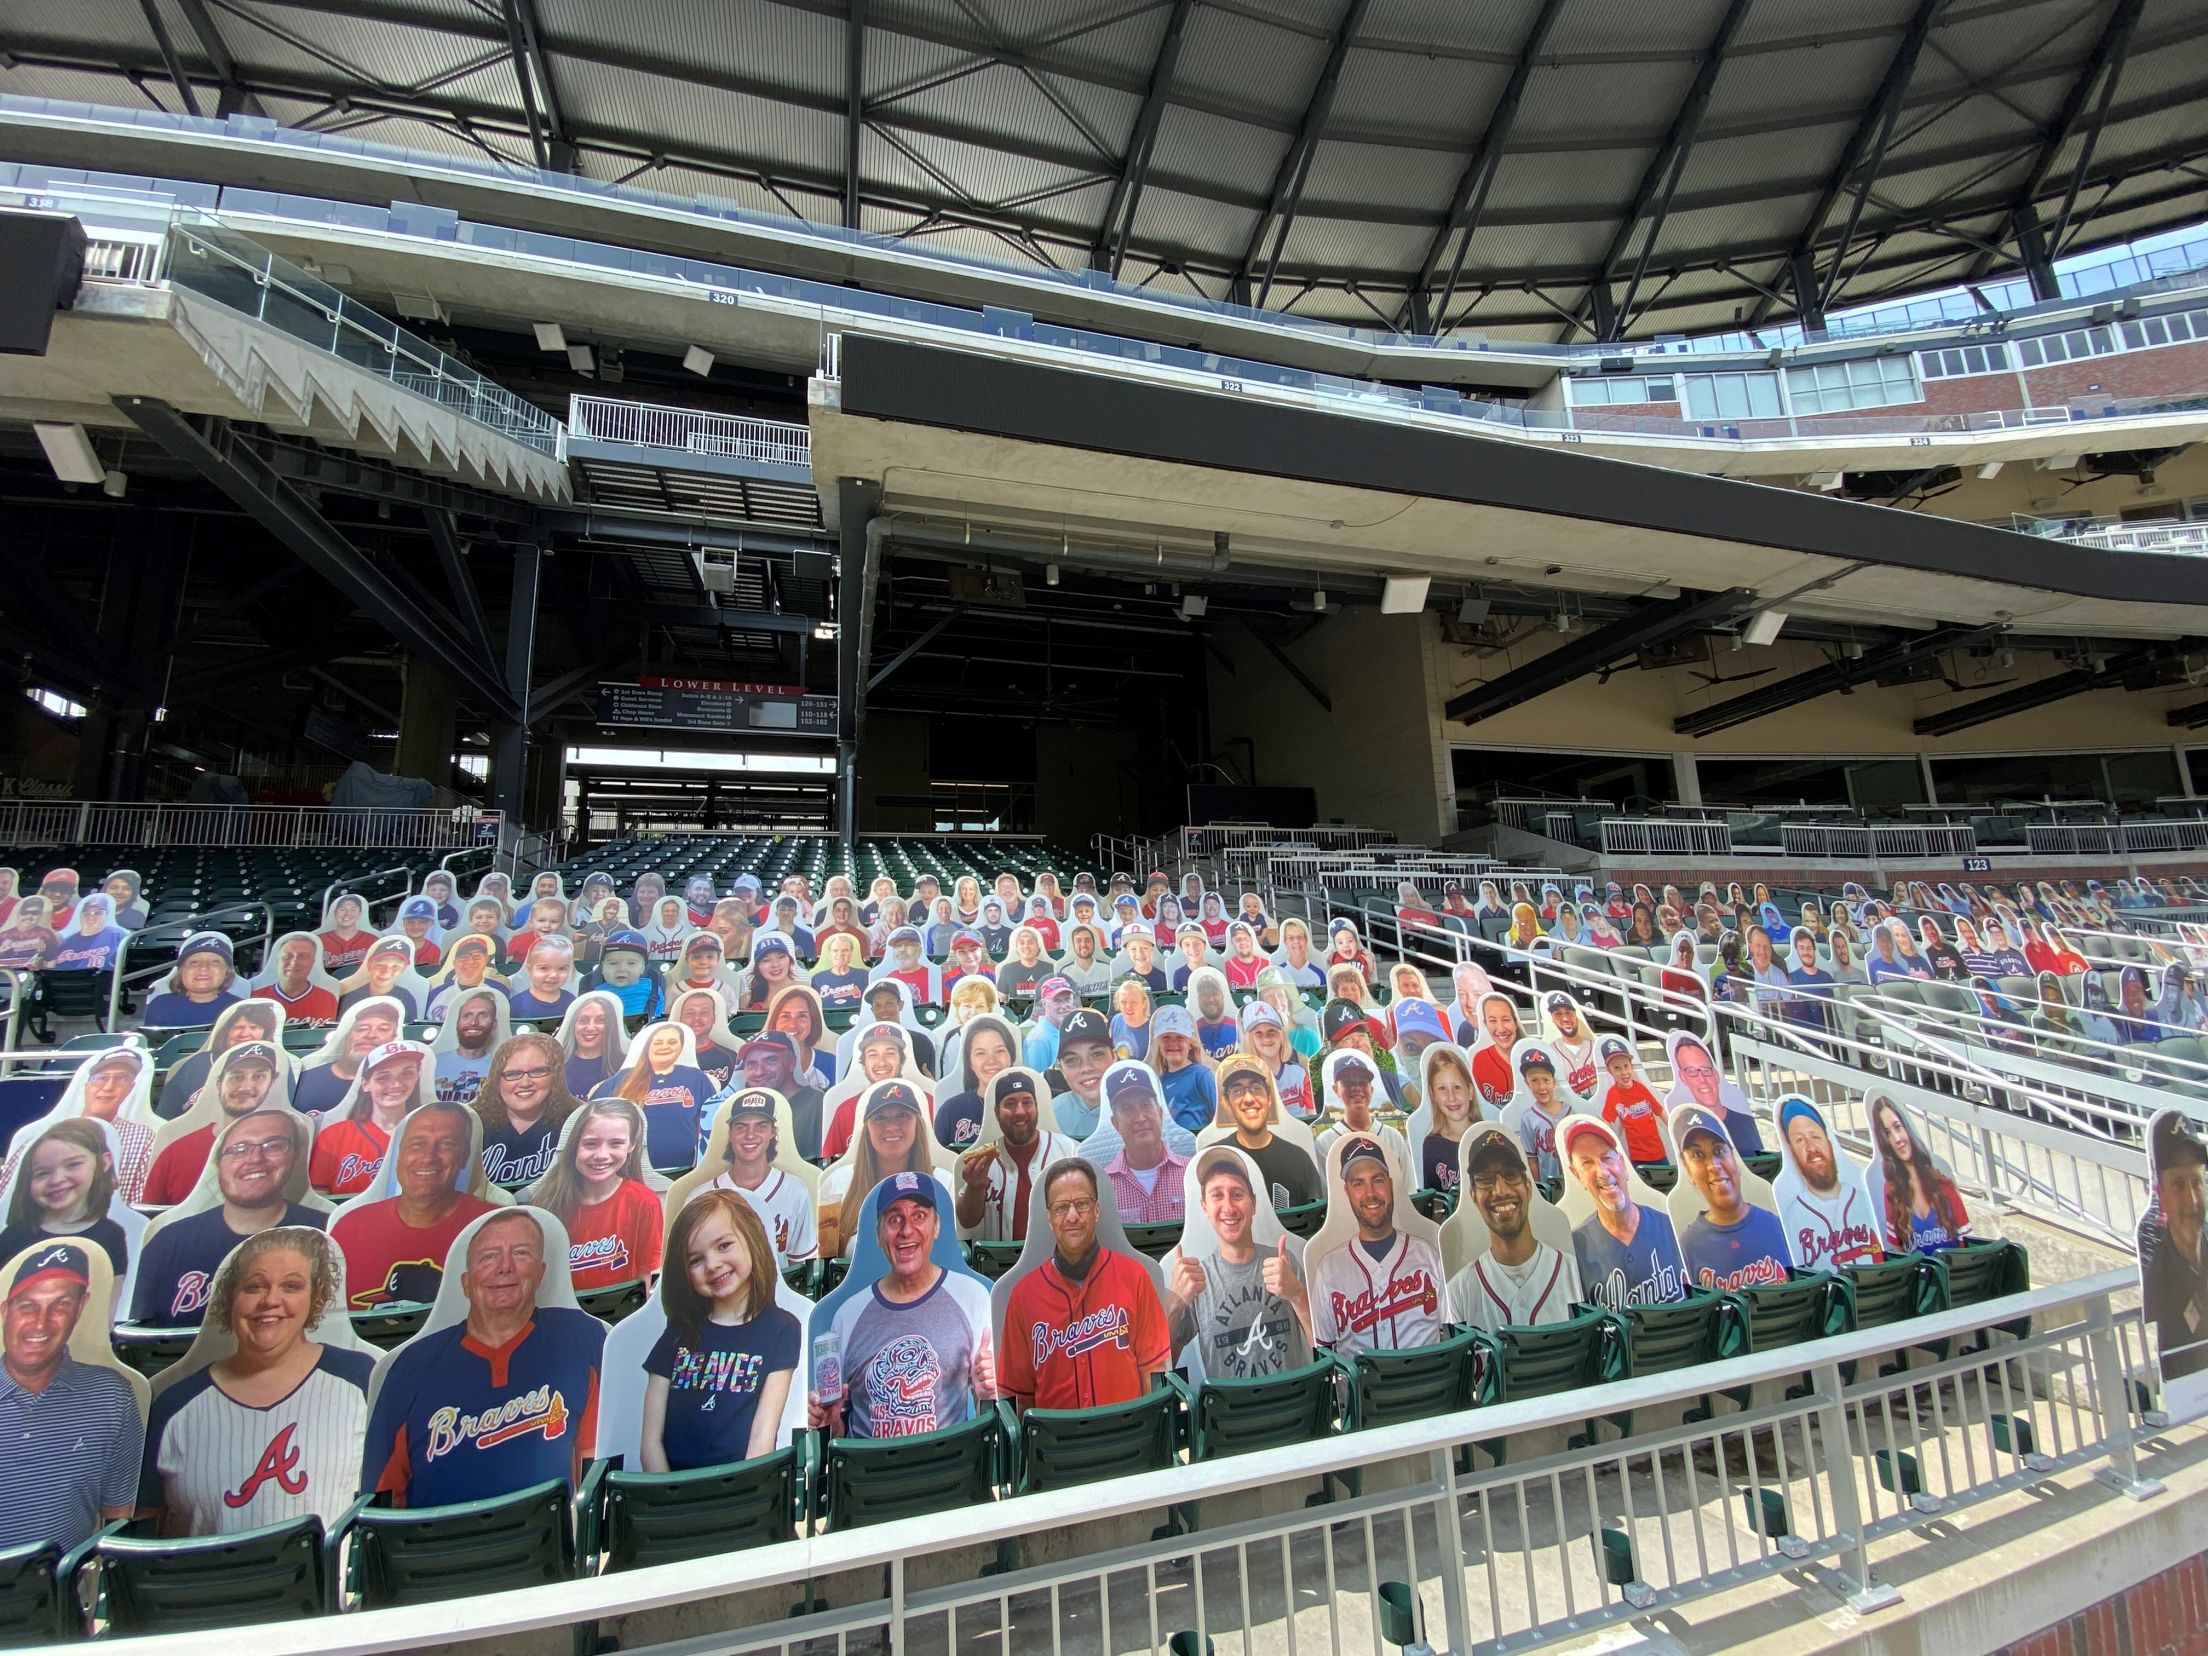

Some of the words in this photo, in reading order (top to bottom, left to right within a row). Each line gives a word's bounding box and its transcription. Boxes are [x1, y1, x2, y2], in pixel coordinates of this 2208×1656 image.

[713, 294, 734, 305] 320
[1224, 382, 1240, 392] 322
[661, 679, 720, 691] LOWER
[733, 683, 785, 695] LEVEL
[1968, 860, 1988, 871] 123
[760, 938, 778, 950] ATL
[1065, 1012, 1088, 1032] A
[1338, 1007, 1354, 1022] A
[239, 1044, 262, 1059] A
[1120, 1068, 1138, 1084] A
[1687, 1113, 1703, 1127] A
[2171, 1114, 2190, 1136] A
[569, 1234, 617, 1263] aves
[1799, 1223, 1869, 1269] Braves
[37, 1247, 69, 1268] A
[1331, 1269, 1424, 1334] Braves
[1032, 1303, 1117, 1371] Braves
[1236, 1311, 1273, 1357] A
[671, 1347, 764, 1394] BRAVES
[1224, 1340, 1289, 1380] BRAVES
[700, 1393, 716, 1411] A
[426, 1384, 551, 1464] Braves
[870, 1414, 937, 1438] BRAVOS
[223, 1421, 309, 1509] A
